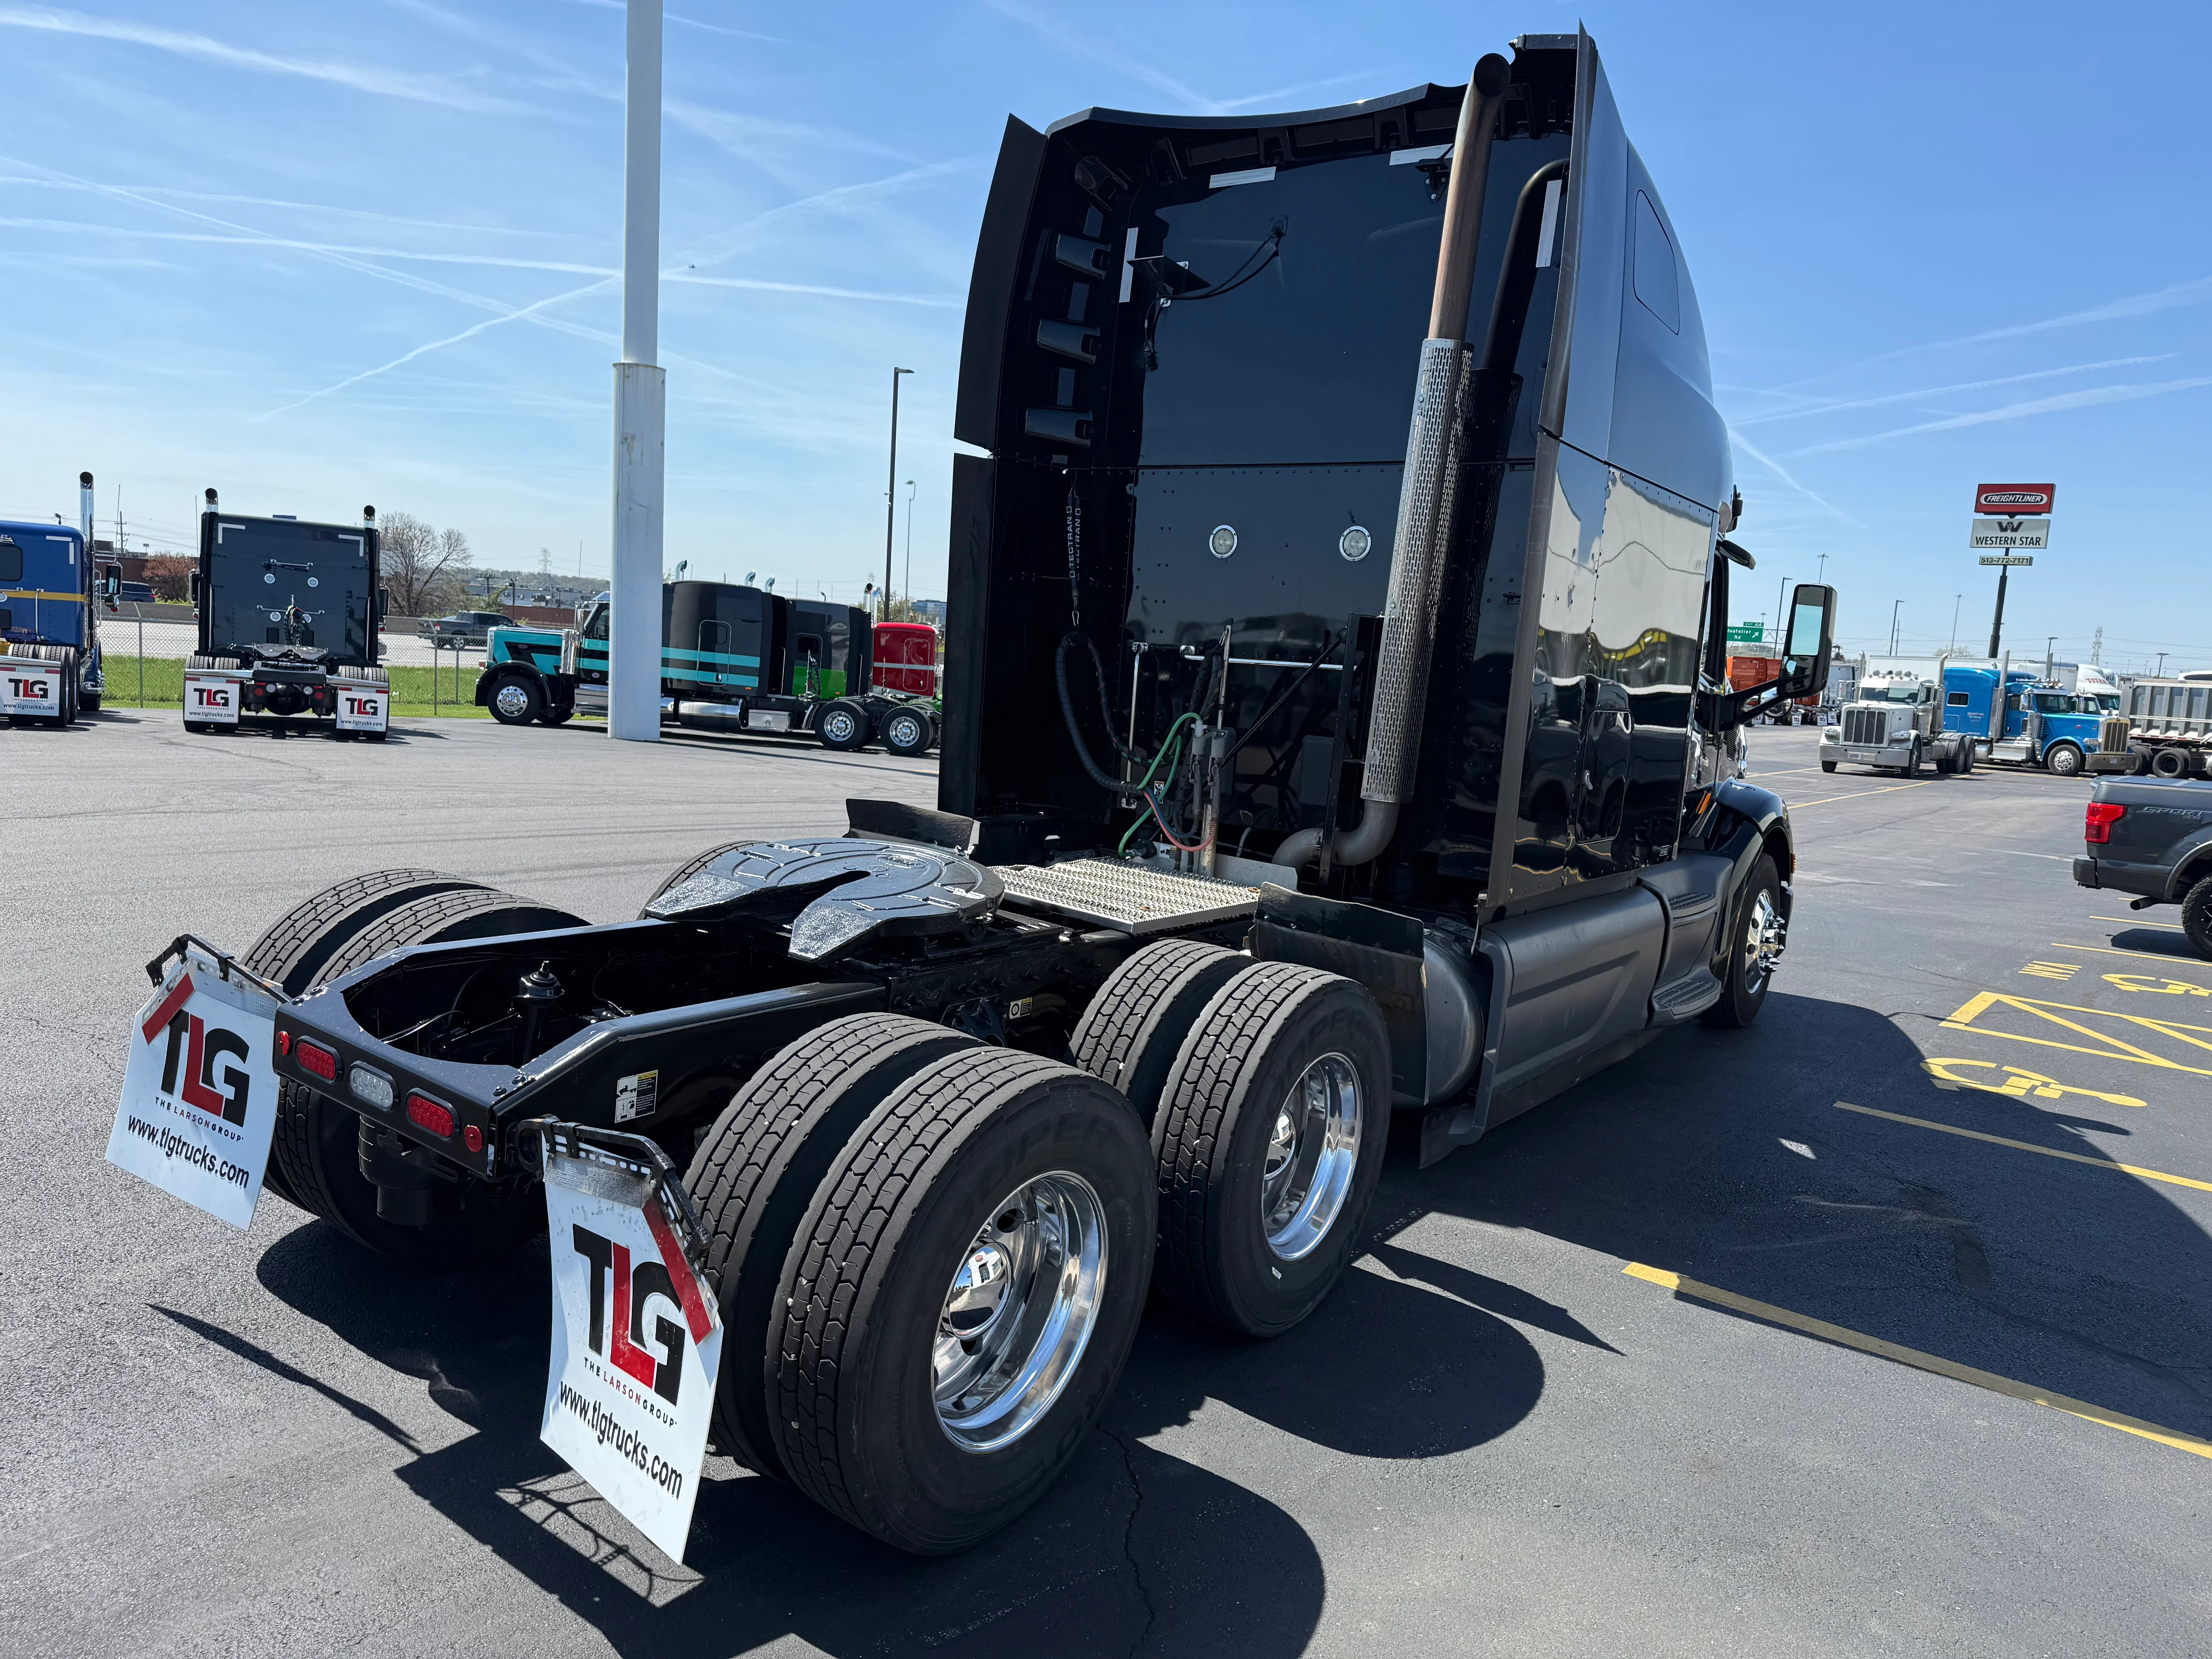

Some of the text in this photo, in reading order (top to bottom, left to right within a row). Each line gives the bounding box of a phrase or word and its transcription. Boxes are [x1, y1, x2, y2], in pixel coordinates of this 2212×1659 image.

[1976, 536, 2041, 545] WESTERN STAR
[8, 678, 48, 699] TLG
[194, 688, 229, 707] TLG
[345, 697, 378, 716] TLG
[2136, 807, 2212, 816] SPORT
[161, 1008, 250, 1127] TLG
[156, 1097, 241, 1142] THE LARSON GROUP
[128, 1115, 249, 1188] www.tlgtrucks.com
[573, 1223, 686, 1407] TLG
[584, 1357, 675, 1428] THE LARSON GROUP
[560, 1381, 682, 1499] www.tlgtrucks.com
